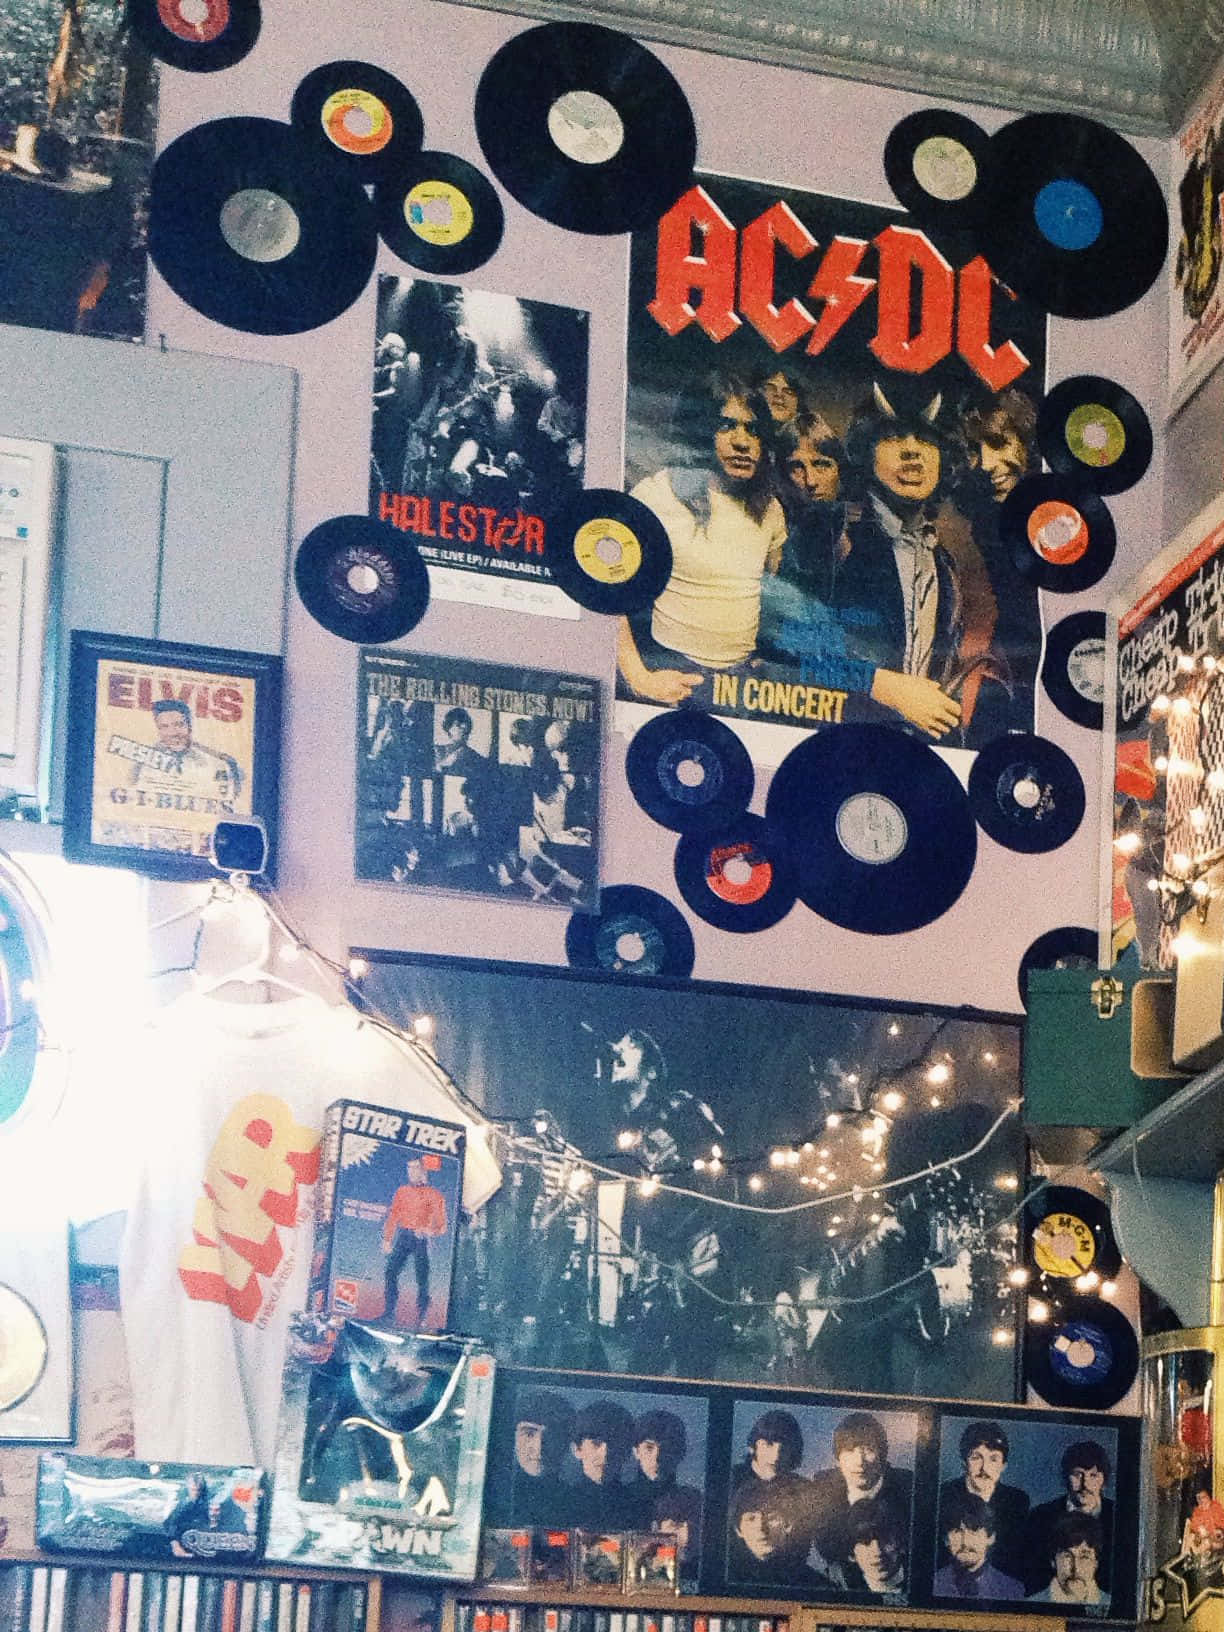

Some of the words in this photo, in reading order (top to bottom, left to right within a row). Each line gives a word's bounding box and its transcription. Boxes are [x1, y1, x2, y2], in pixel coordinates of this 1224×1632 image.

[647, 184, 1030, 393] AC/DC
[108, 673, 245, 723] ELVIS
[713, 673, 738, 708] IN
[743, 680, 848, 724] CONCERT
[344, 1106, 401, 1139] STAR
[405, 1120, 462, 1153] TREK
